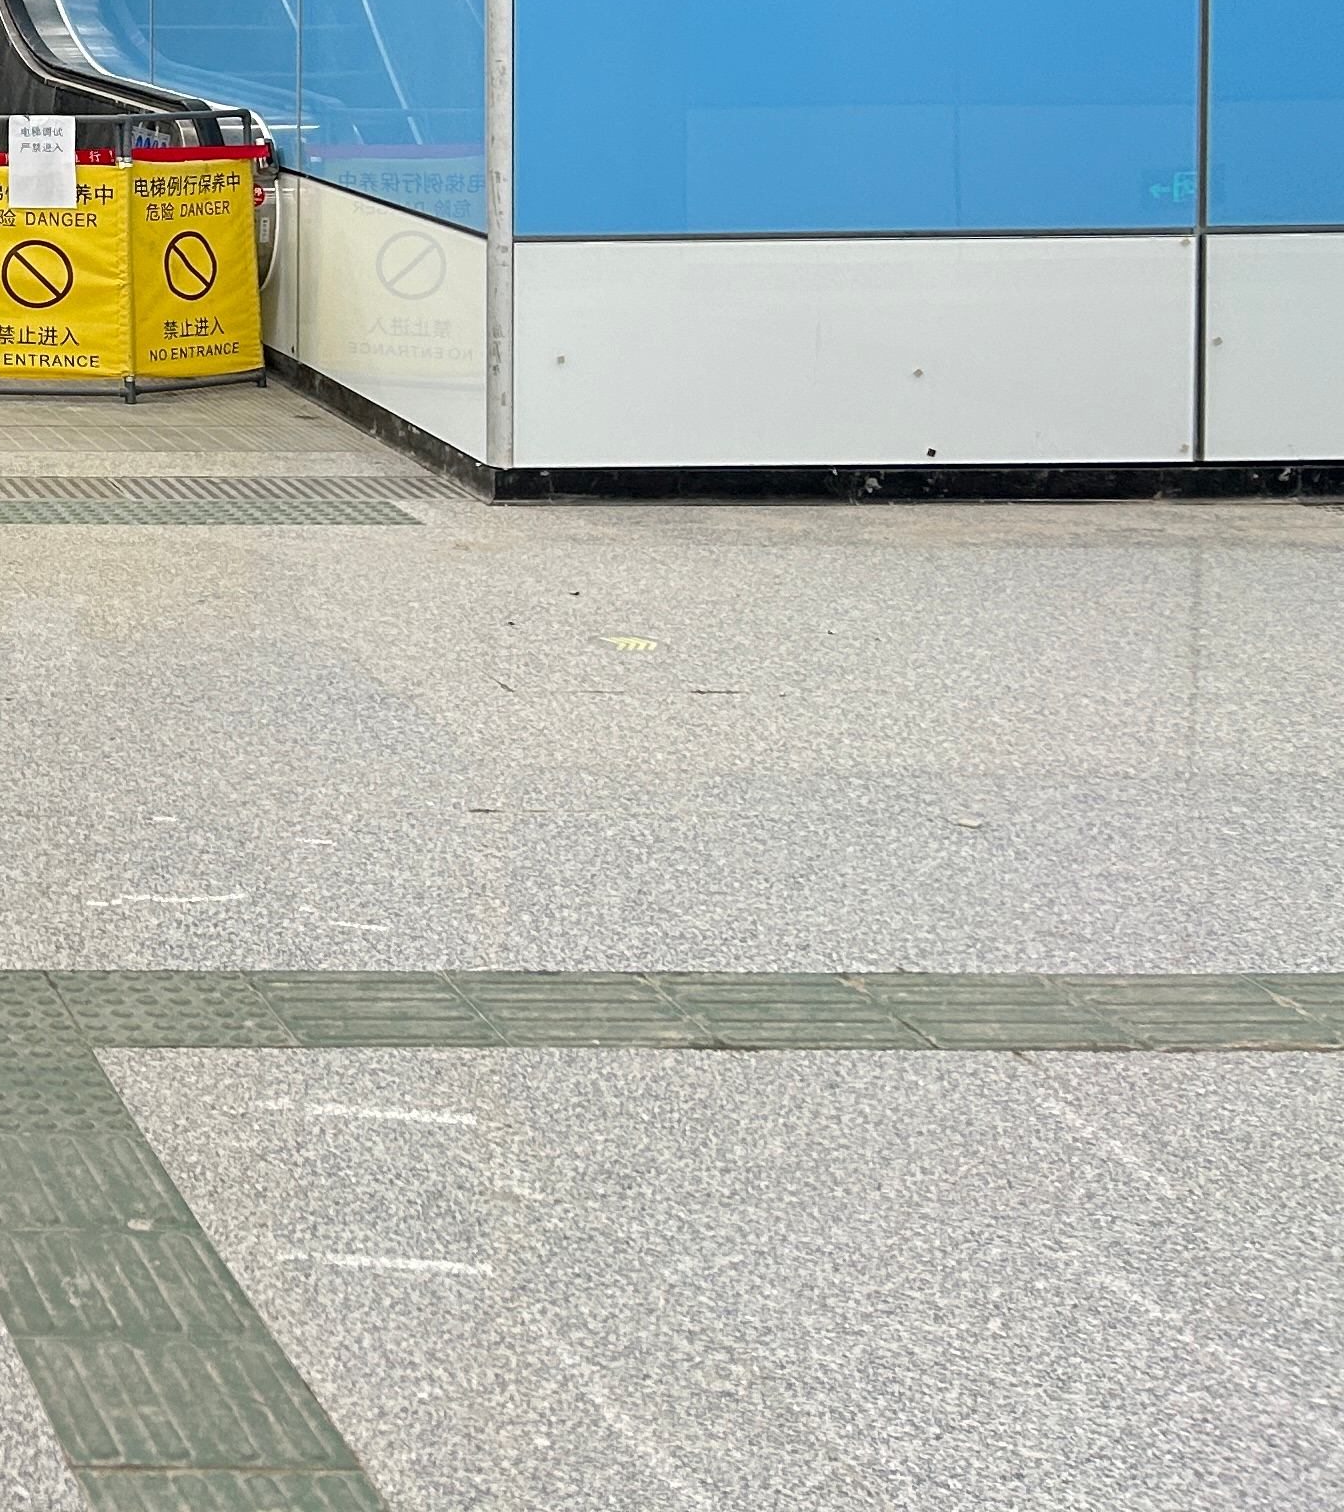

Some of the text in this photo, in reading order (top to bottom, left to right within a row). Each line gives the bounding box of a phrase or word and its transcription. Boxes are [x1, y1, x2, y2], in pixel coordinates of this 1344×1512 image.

[134, 171, 241, 199] 电梯例行保养中
[25, 211, 98, 228] DANGER
[145, 200, 231, 222] 危险 DANGER
[163, 316, 225, 340] 禁止进入
[3, 353, 100, 368] ENTRANCE
[149, 342, 240, 362] NO ENTRANCE
